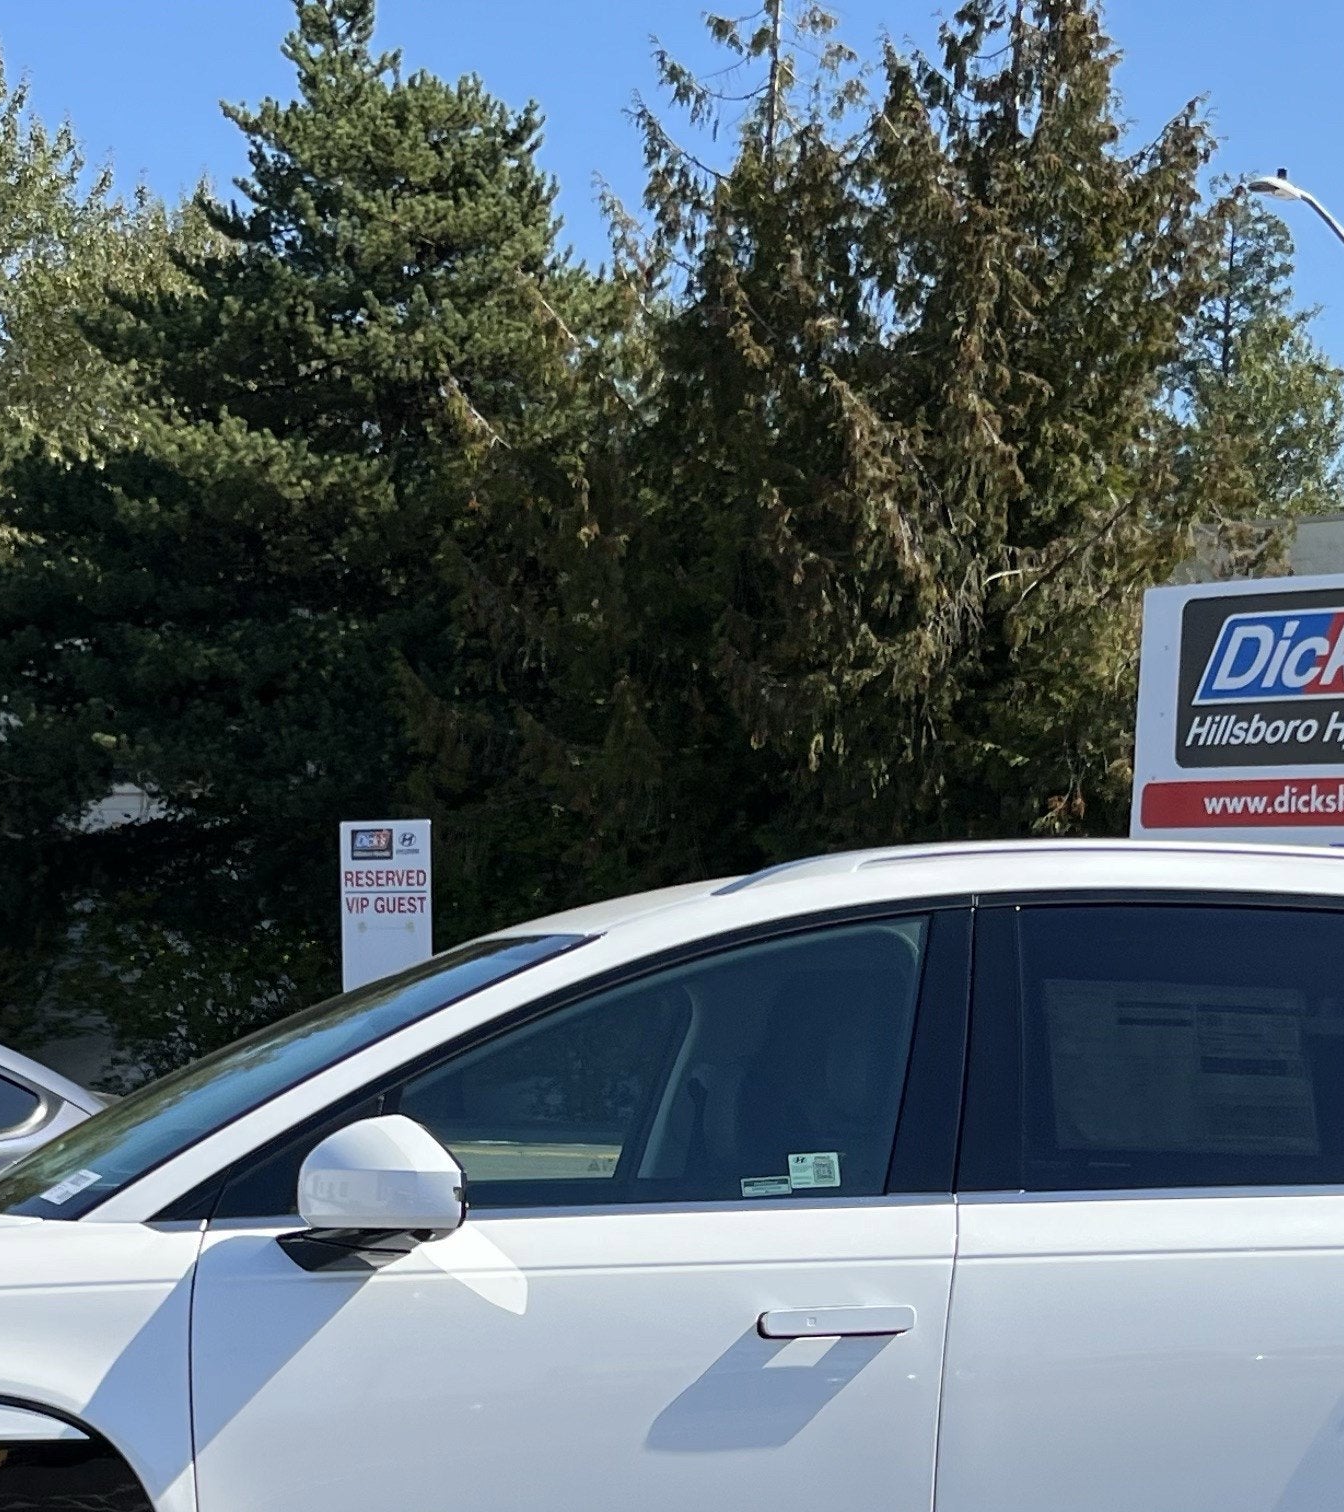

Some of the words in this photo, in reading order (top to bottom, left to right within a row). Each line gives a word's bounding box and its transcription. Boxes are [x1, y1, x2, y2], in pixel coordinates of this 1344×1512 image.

[1185, 713, 1318, 746] Hillsboro
[344, 869, 427, 888] RESERVED
[345, 896, 370, 914] VIP
[374, 896, 427, 914] GUEST
